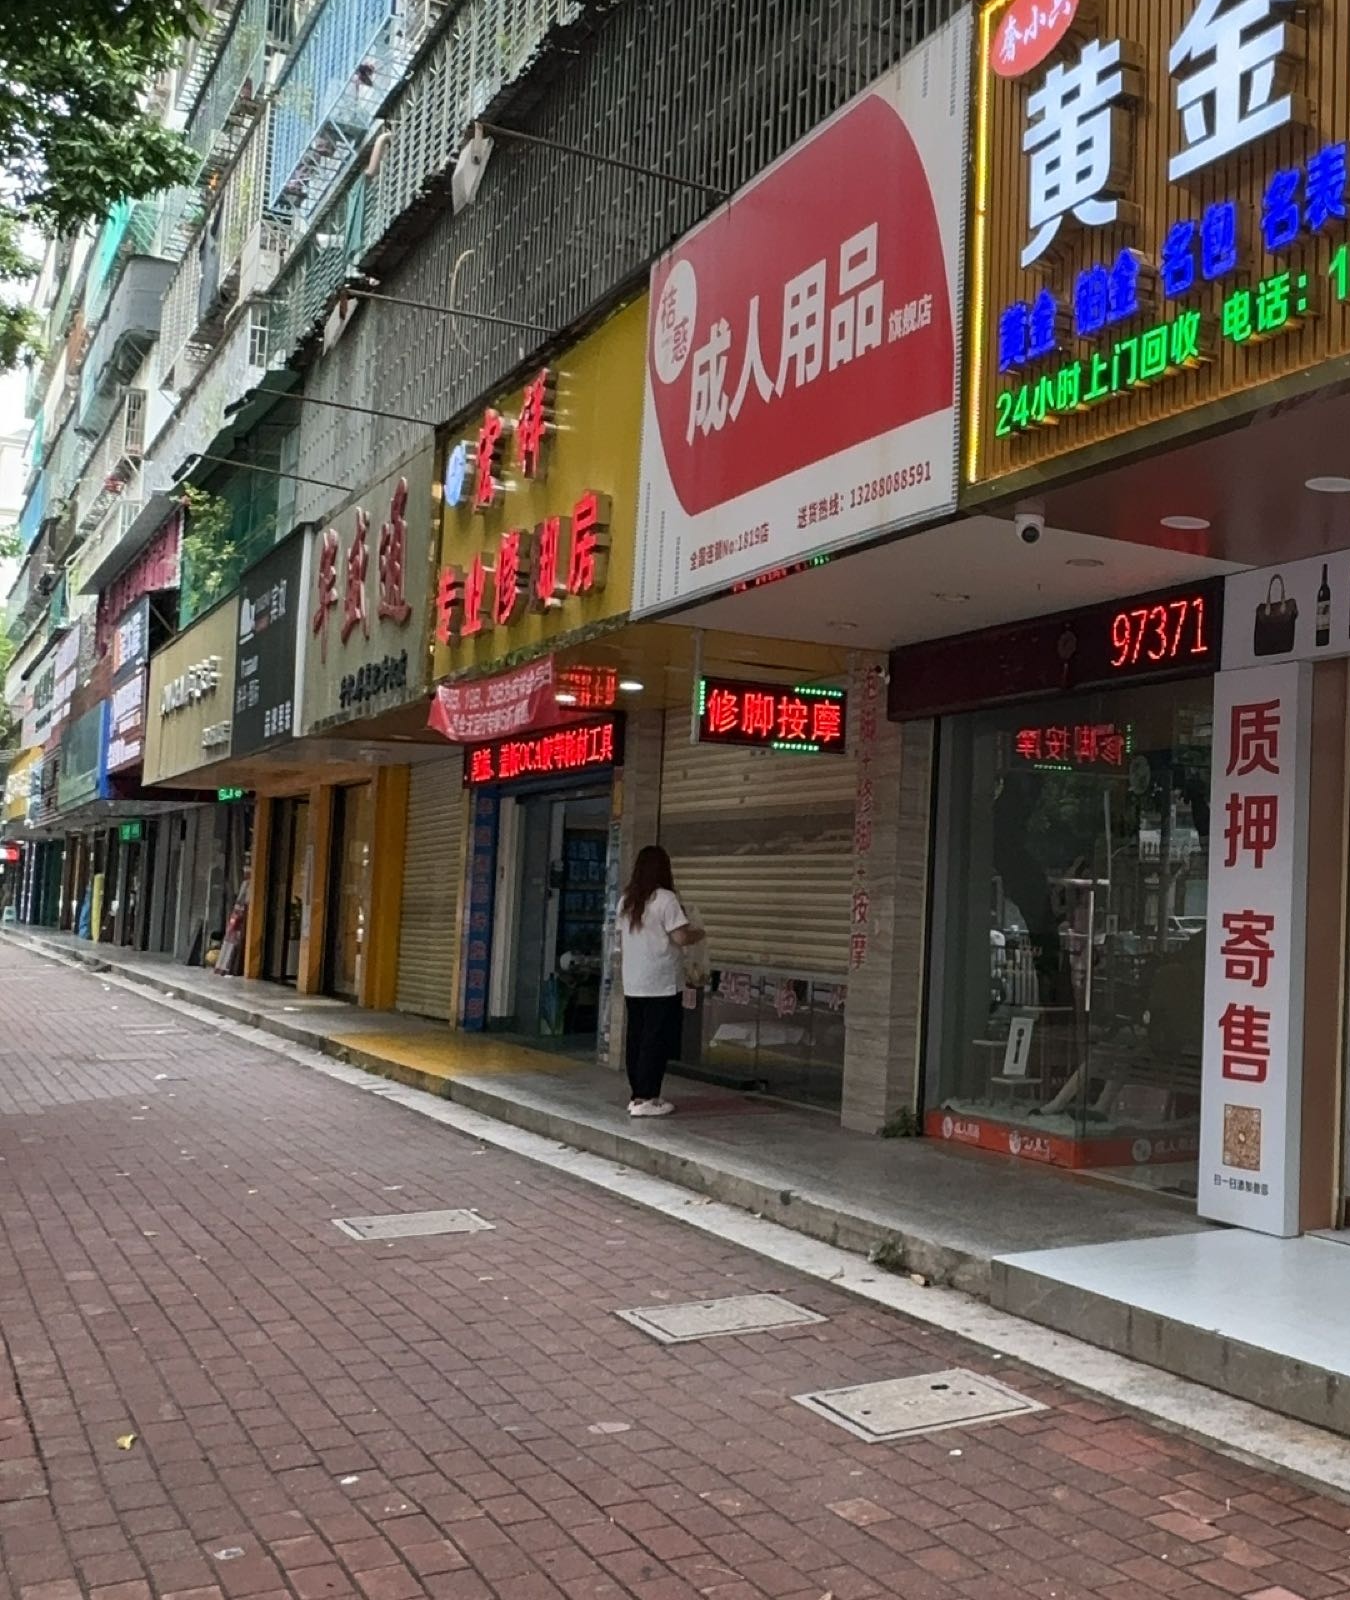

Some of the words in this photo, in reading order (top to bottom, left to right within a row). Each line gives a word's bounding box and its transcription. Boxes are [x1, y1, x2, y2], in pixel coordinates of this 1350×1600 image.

[1000, 288, 1057, 372] 黄金
[1162, 201, 1236, 296] 名包
[1261, 142, 1349, 251] 名表
[686, 222, 884, 447] 成人用品
[888, 293, 933, 344] 旗舰店
[996, 310, 1201, 438] 24小时上门回收
[1110, 598, 1208, 666] 97371
[708, 688, 841, 743] 修脚按摩
